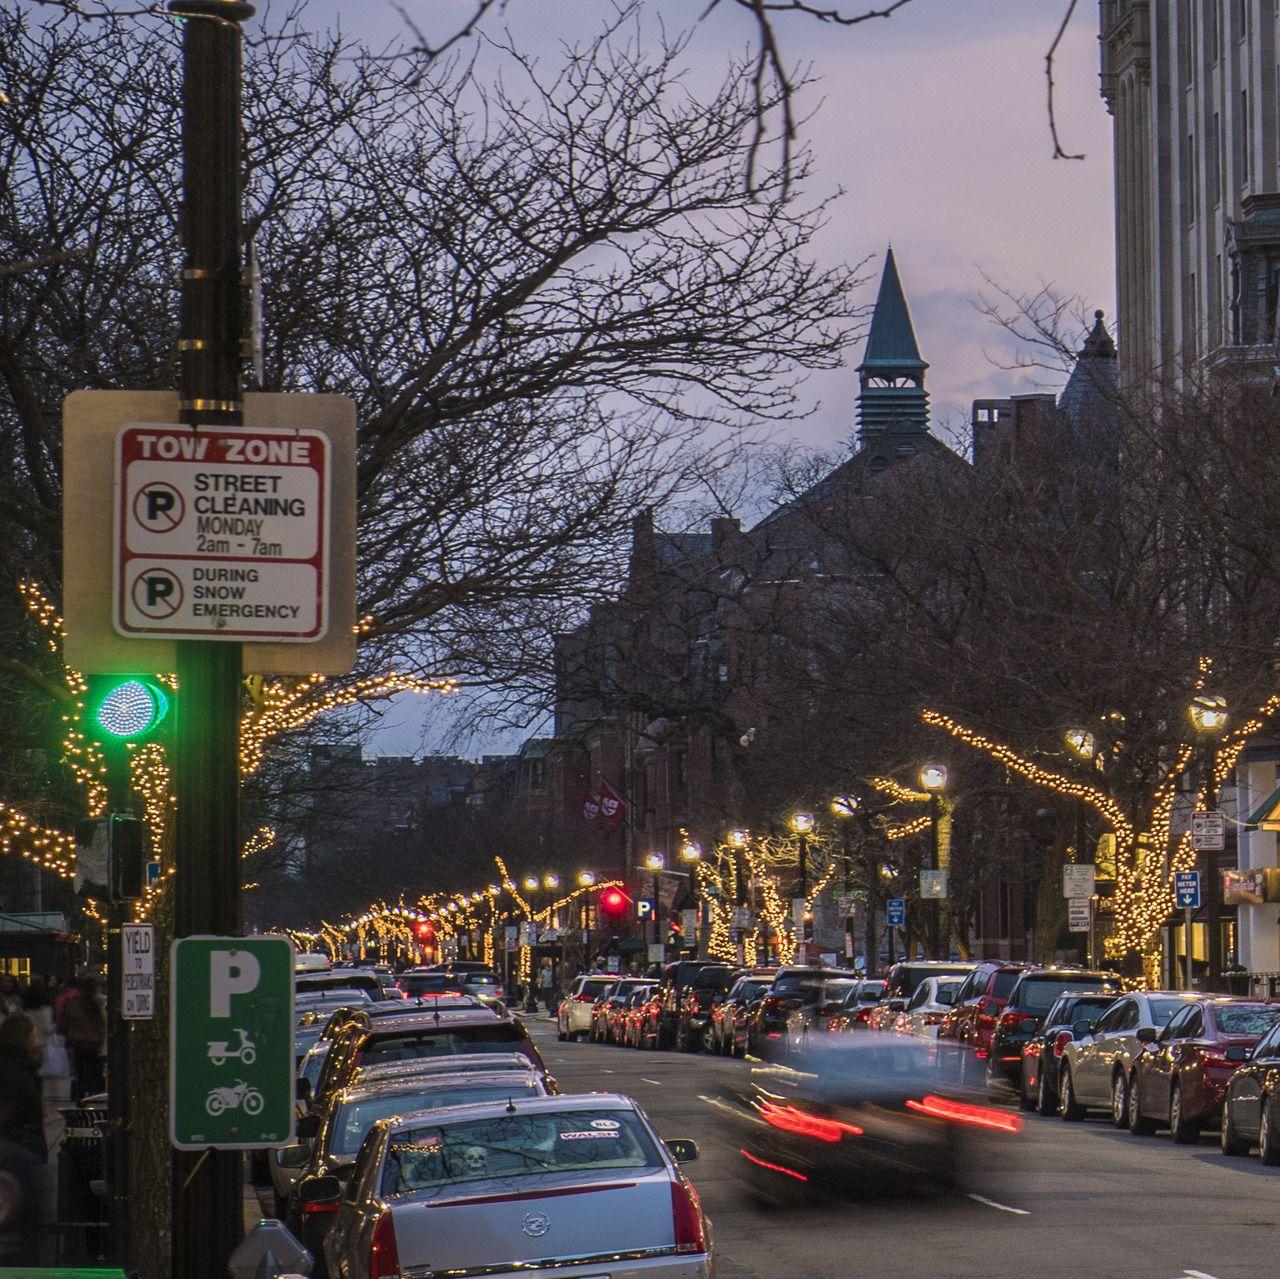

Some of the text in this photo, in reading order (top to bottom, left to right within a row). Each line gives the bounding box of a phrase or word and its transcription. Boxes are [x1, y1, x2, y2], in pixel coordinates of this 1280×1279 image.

[136, 435, 311, 464] TOW ZONE
[194, 473, 282, 494] STREET
[194, 496, 306, 517] CLEANING
[196, 516, 264, 537] MONDAY
[196, 535, 230, 553] 2am
[251, 537, 282, 556] 7am
[193, 568, 259, 582] DURING
[193, 586, 246, 600] SNOW
[193, 604, 300, 619] EMERGENCY
[638, 901, 650, 916] P
[126, 931, 150, 954] YIELD
[210, 950, 260, 1018] P
